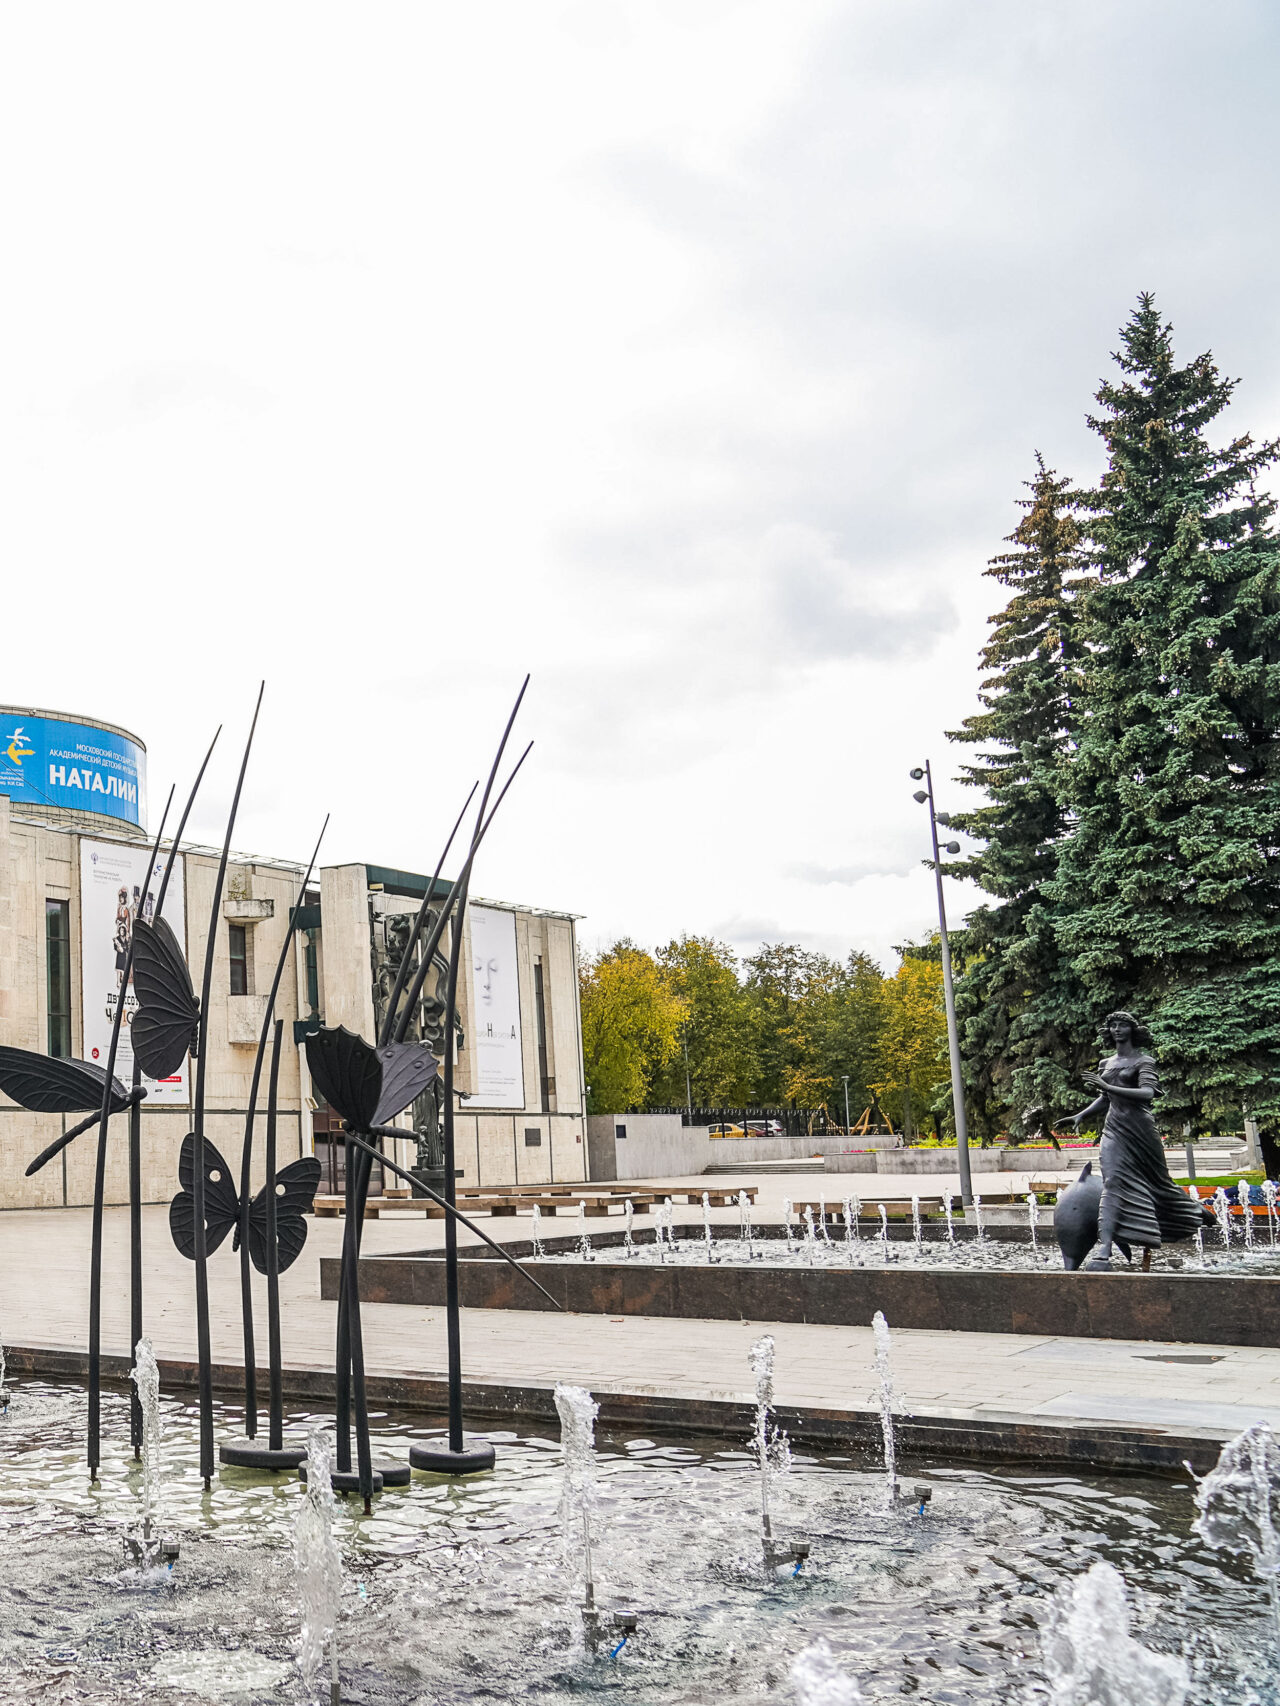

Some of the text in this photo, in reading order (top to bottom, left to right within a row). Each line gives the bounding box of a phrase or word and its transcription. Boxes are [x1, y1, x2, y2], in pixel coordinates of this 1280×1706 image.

[49, 749, 102, 765] АКАДЕМИЧЕСКИЙ
[102, 758, 123, 771] ДЕТСКИЙ
[76, 743, 112, 759] МОСКОВСКИЙ
[49, 764, 137, 804] НАТАЛИИ
